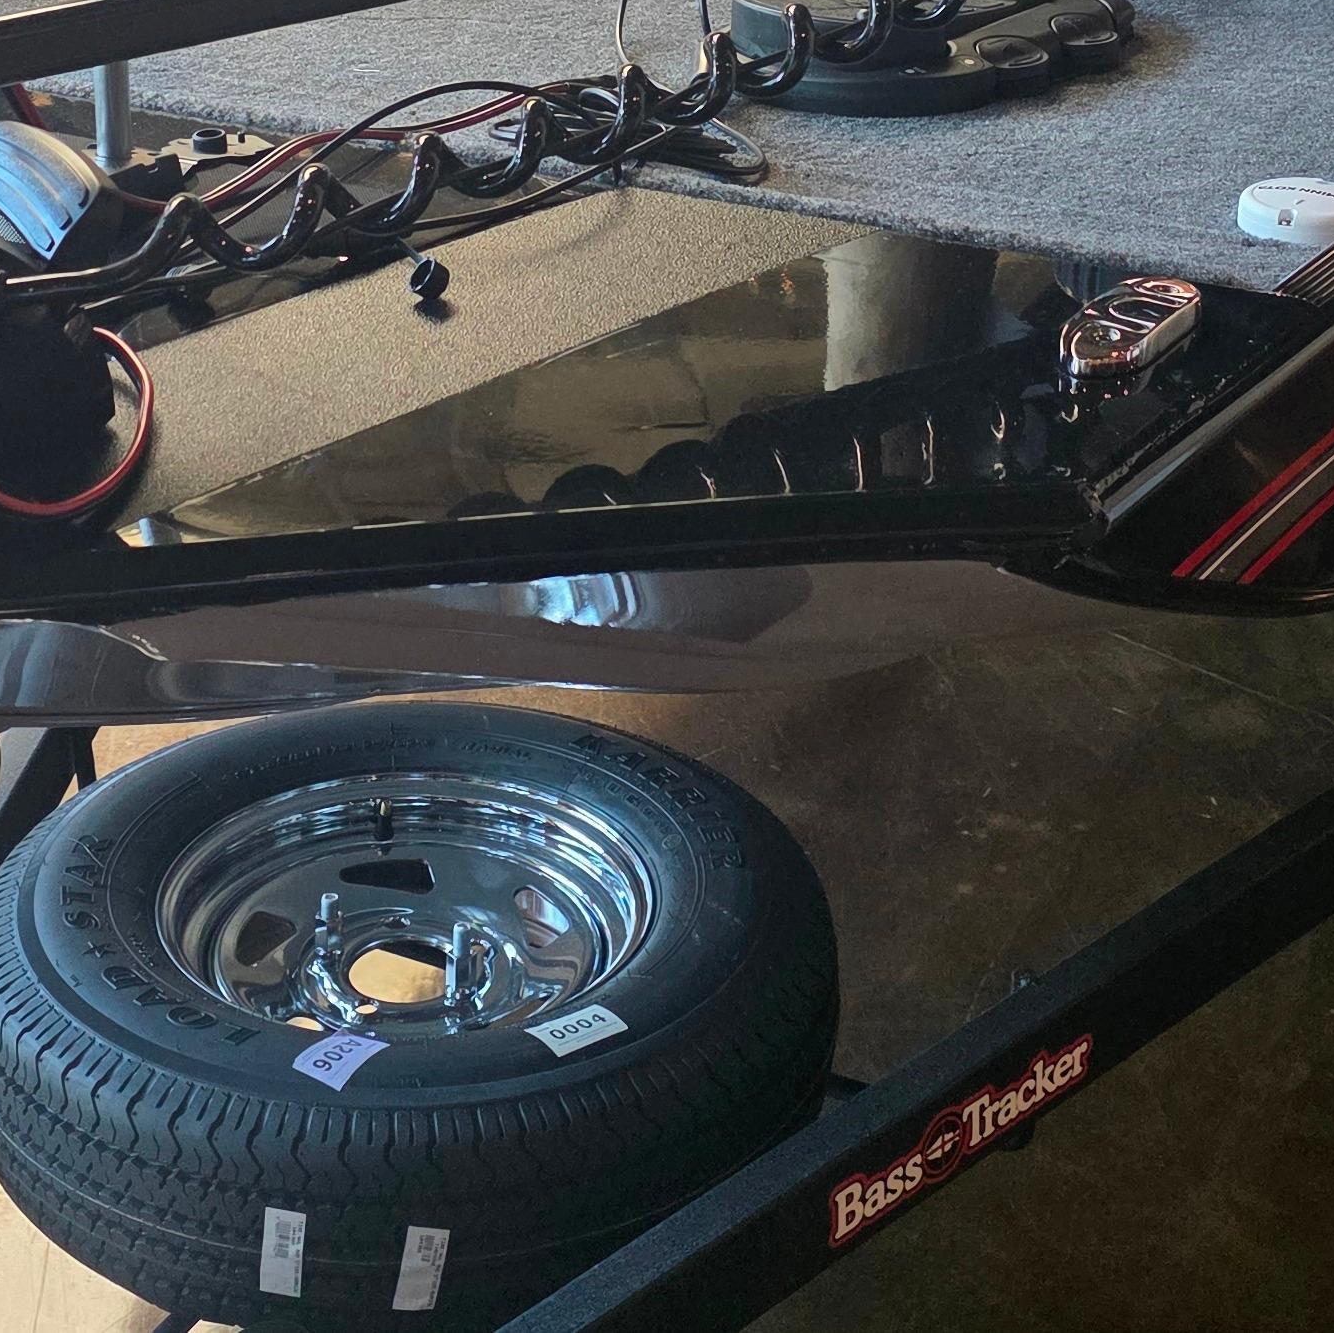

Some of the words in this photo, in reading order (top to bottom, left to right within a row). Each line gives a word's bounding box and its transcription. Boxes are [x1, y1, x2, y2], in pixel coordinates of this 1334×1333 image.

[59, 834, 112, 930] STAR
[100, 965, 262, 1047] LOAD
[549, 1012, 608, 1040] 0004
[312, 1038, 364, 1073] A206
[835, 1153, 924, 1240] Bass
[962, 1041, 1089, 1147] Tracker
